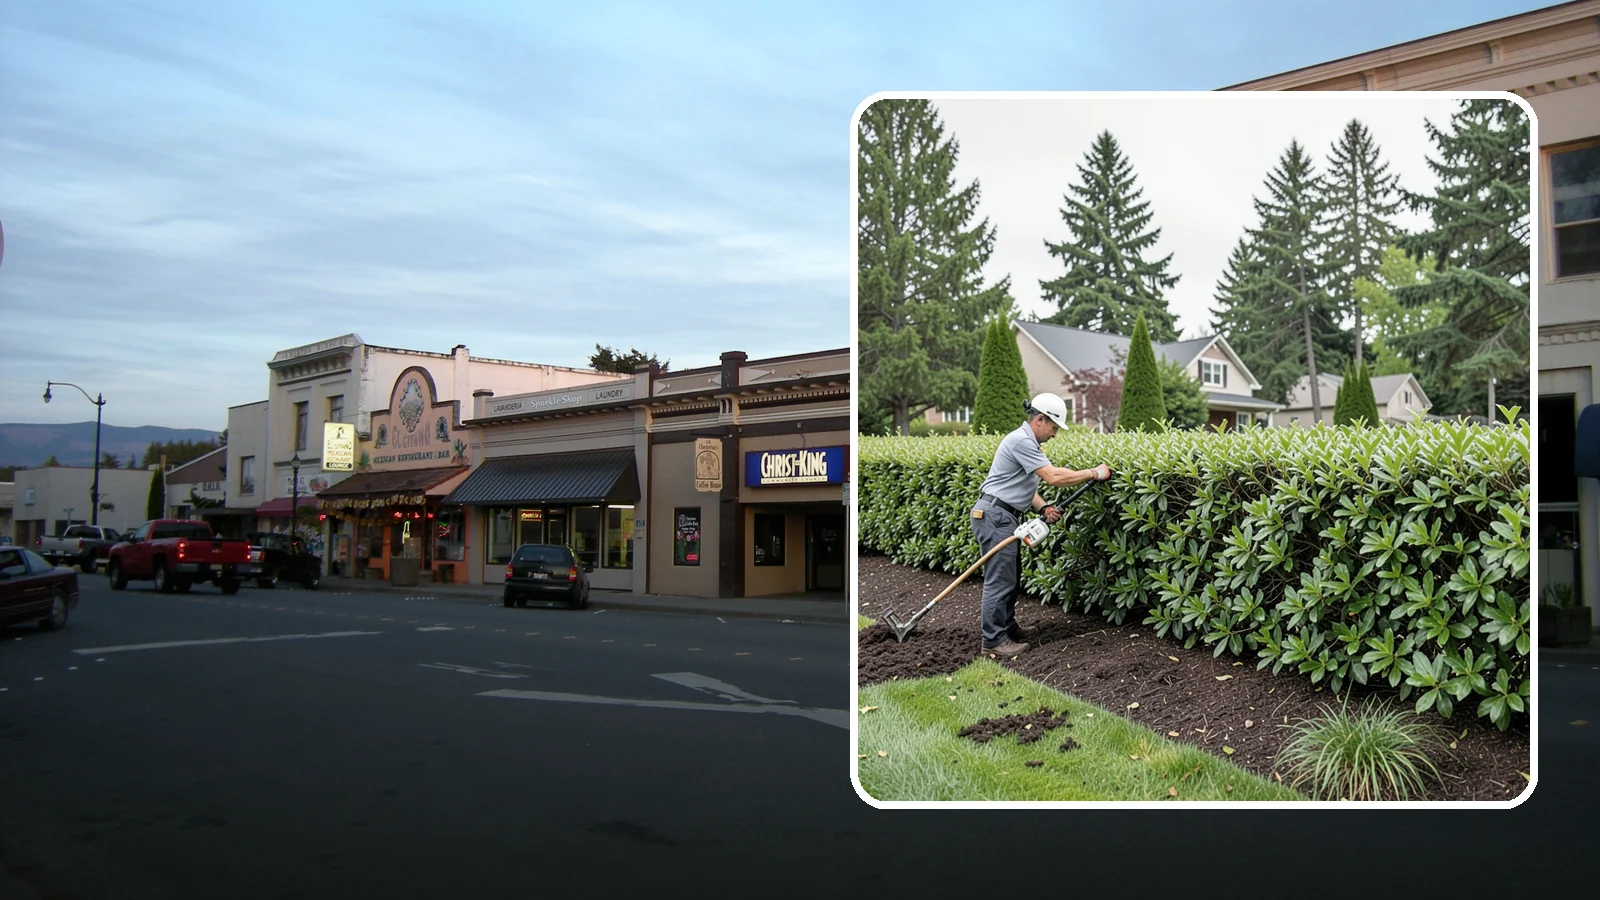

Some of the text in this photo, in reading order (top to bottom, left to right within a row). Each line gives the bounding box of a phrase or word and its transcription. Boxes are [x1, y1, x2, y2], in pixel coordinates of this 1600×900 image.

[493, 389, 624, 412] LAVANDERIA Sparkle Shop LAUNDRY
[374, 454, 397, 463] MEXICAN
[397, 451, 433, 462] RESTAURANT
[437, 450, 450, 459] BAR
[761, 450, 827, 478] CHRIST KING
[696, 480, 709, 489] Coffee
